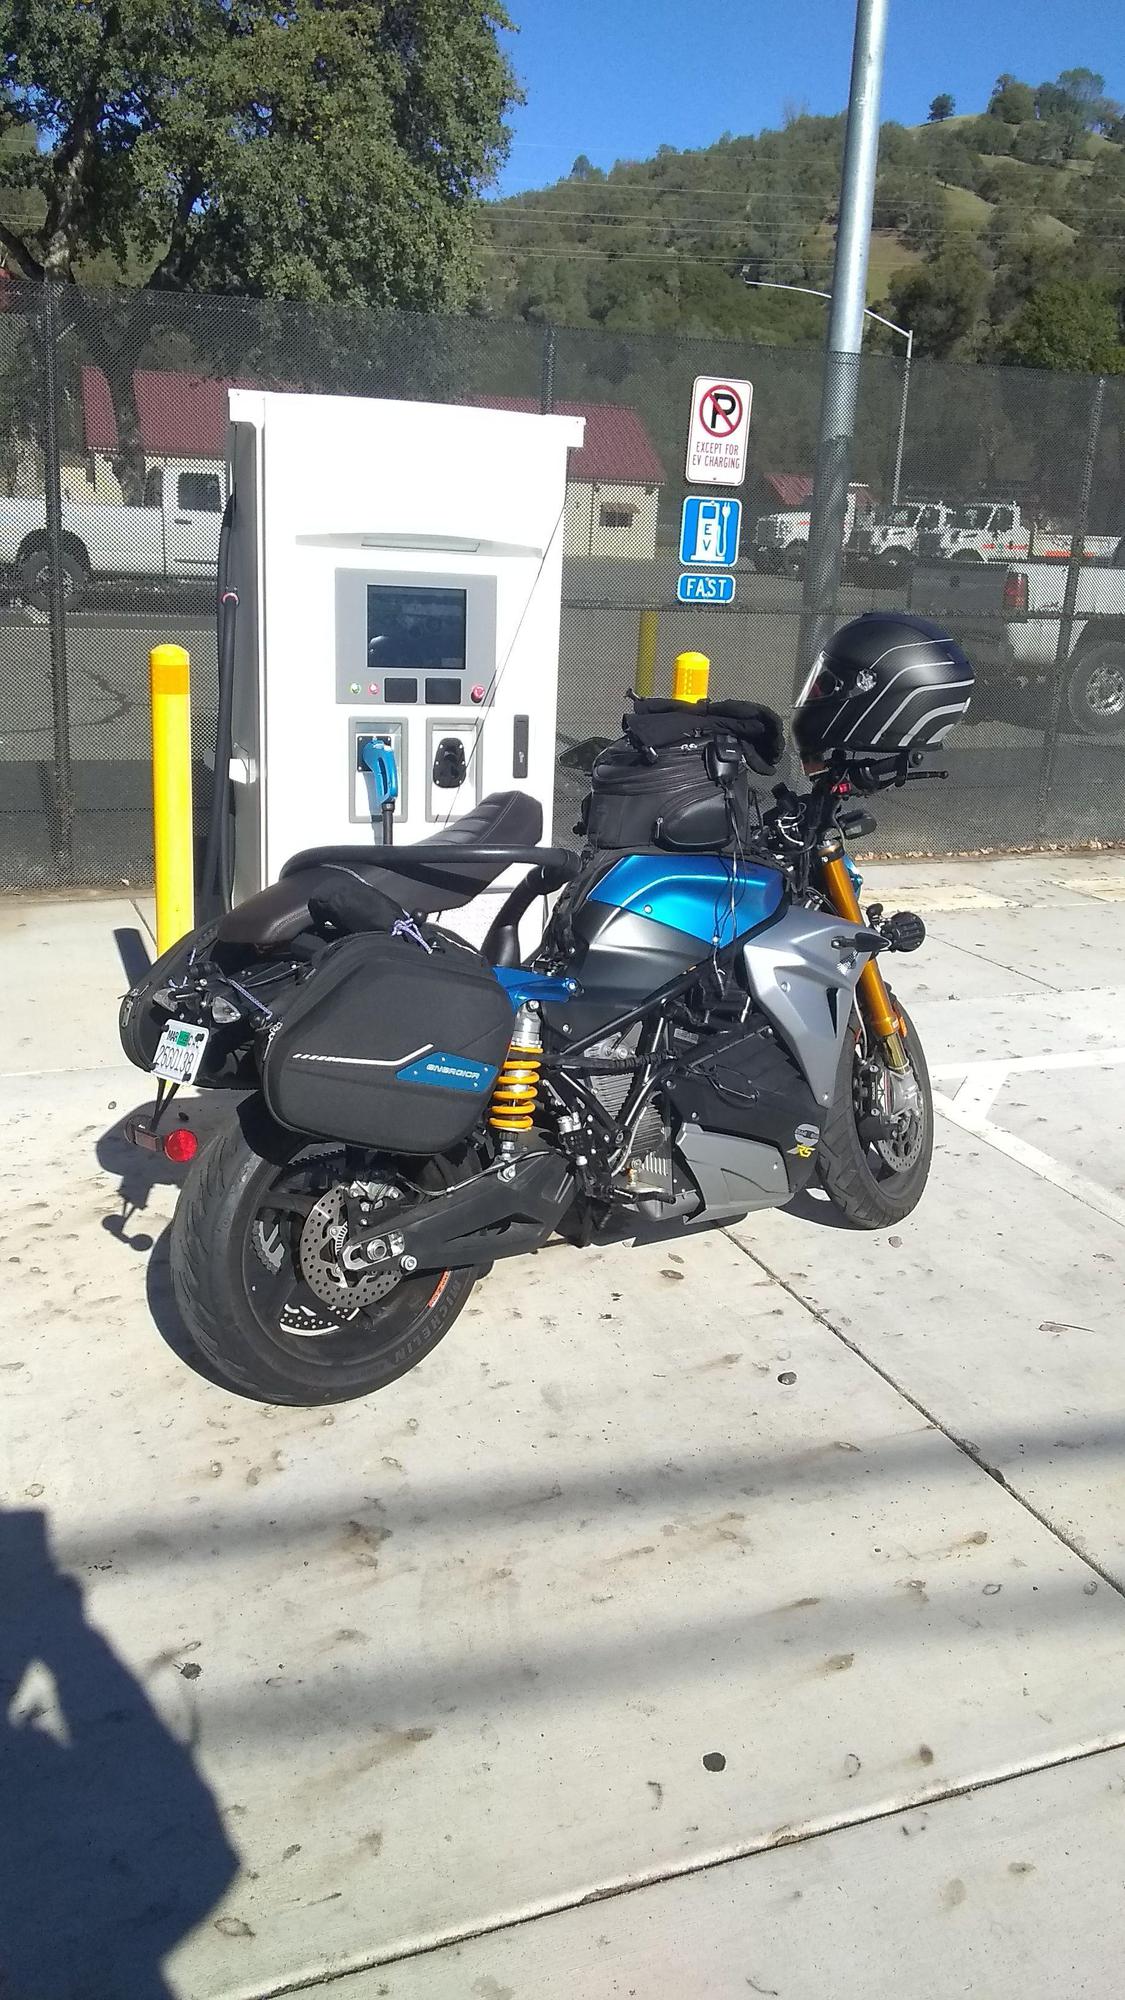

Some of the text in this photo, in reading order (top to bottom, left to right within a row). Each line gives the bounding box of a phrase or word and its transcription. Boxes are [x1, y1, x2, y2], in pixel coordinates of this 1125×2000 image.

[696, 441, 740, 456] EXCEPT FOR
[692, 454, 741, 470] EV CHARGING
[686, 578, 728, 598] FAST
[394, 1278, 462, 1364] MICHELIN
